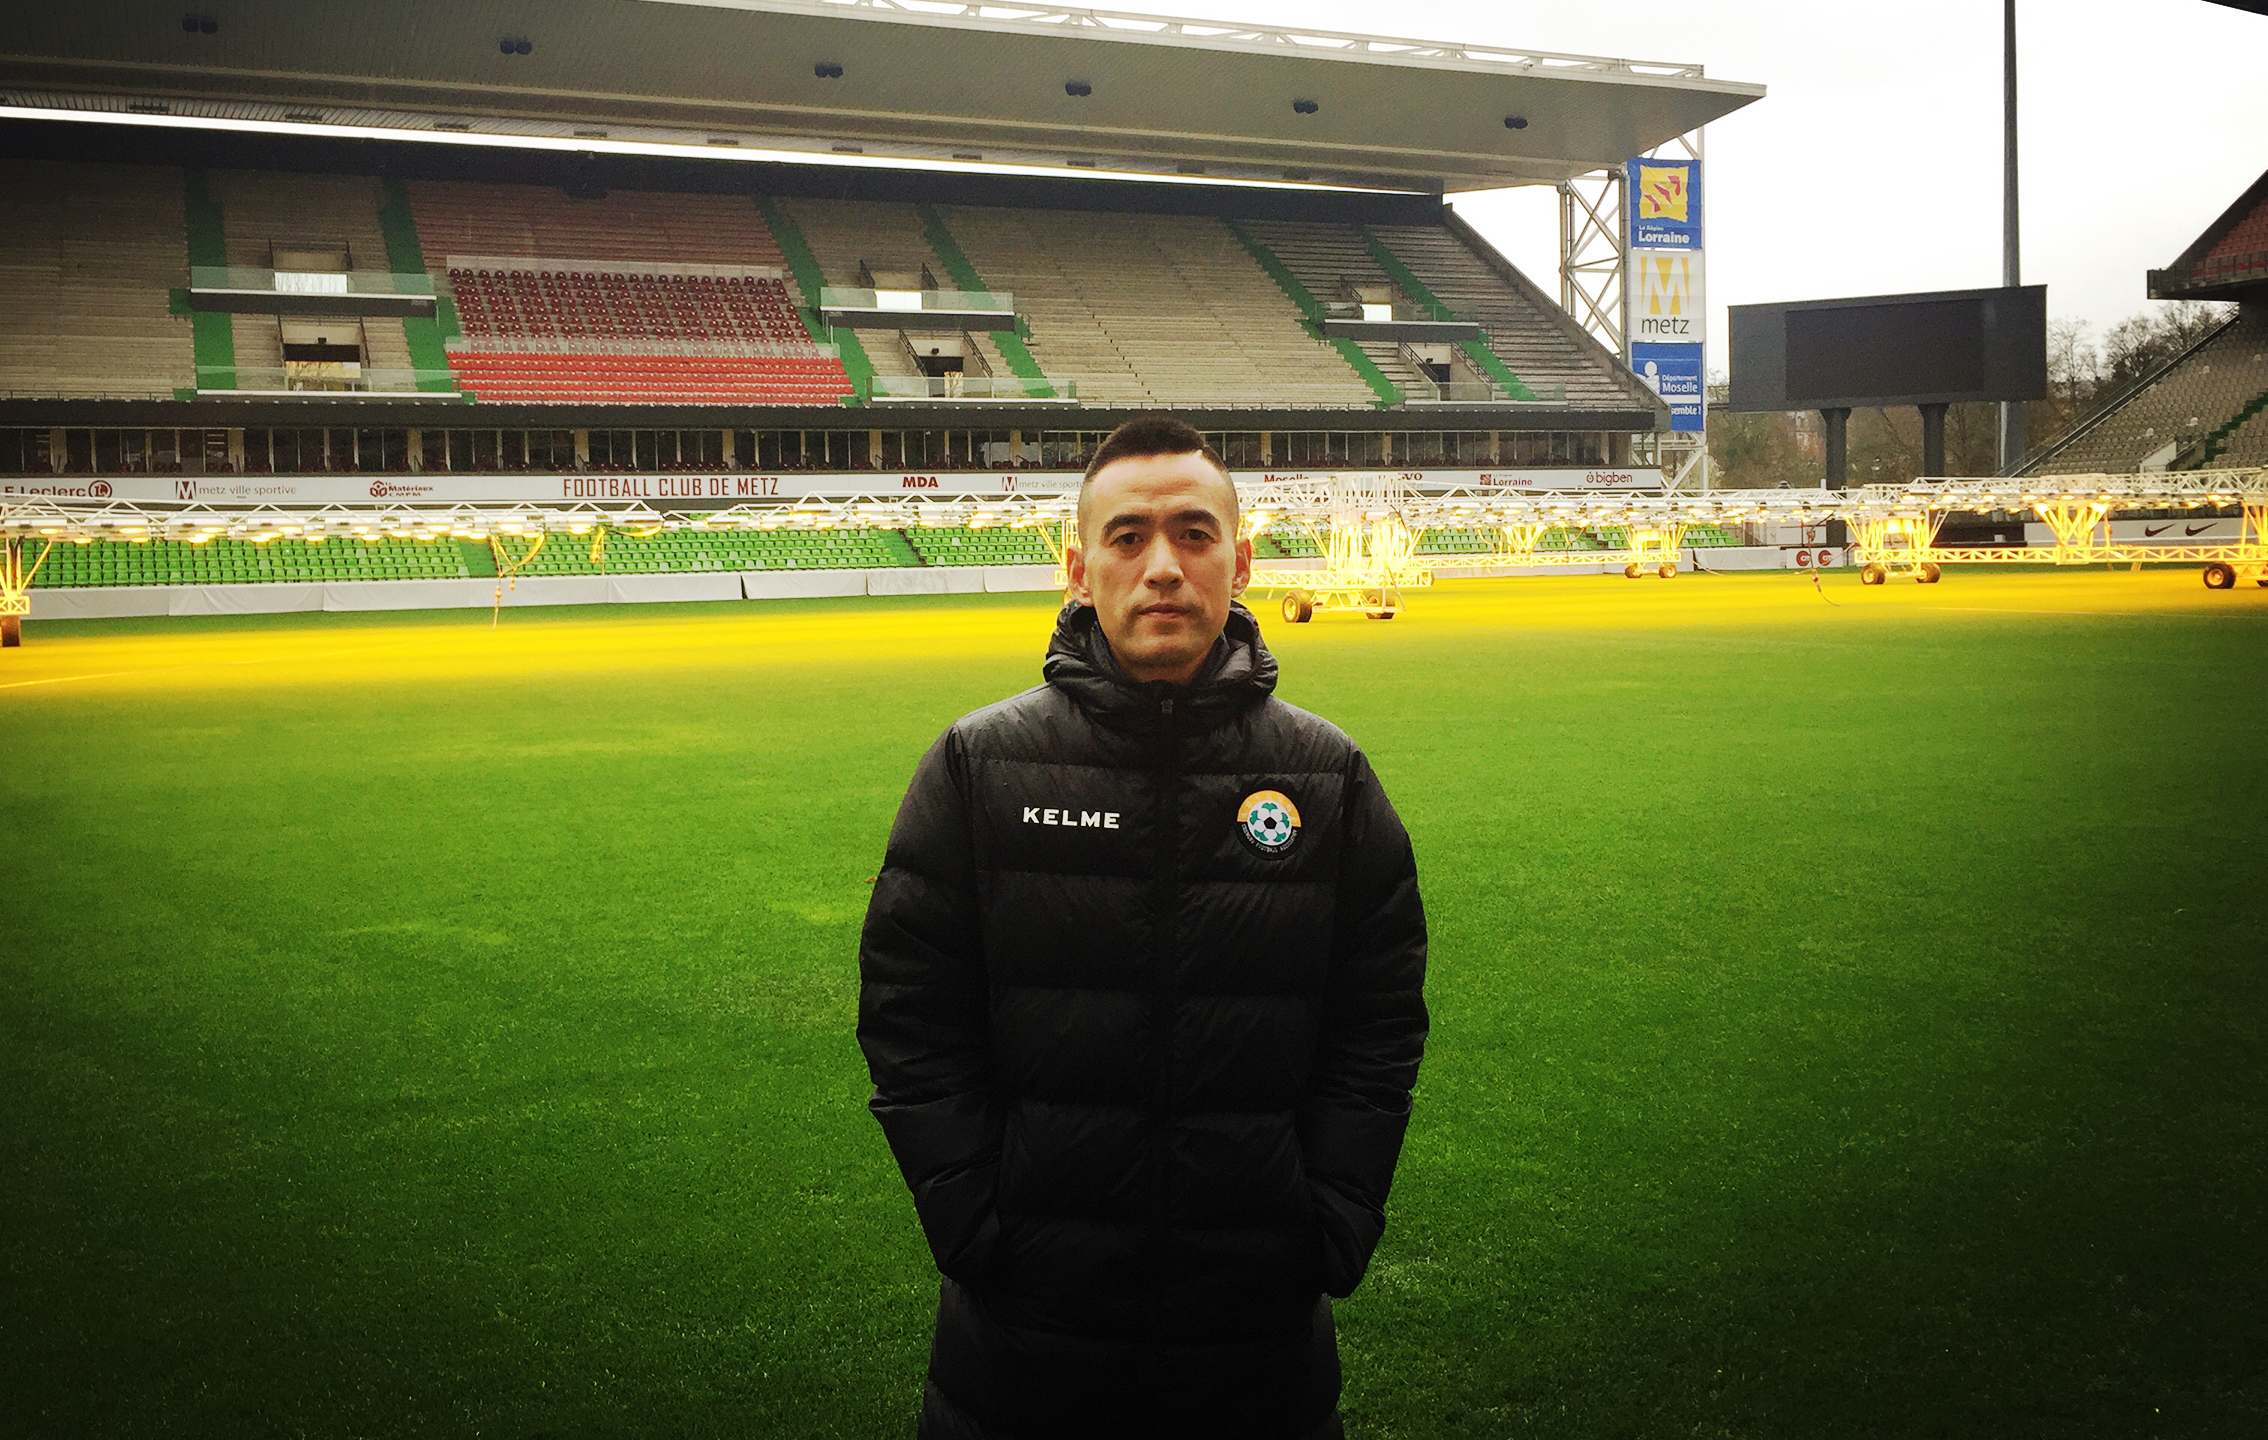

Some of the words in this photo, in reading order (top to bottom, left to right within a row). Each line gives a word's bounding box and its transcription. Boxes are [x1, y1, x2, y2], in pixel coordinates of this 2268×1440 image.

[1638, 231, 1690, 243] Lorraine
[1641, 317, 1690, 334] metz
[1662, 381, 1698, 392] Moselle
[902, 476, 939, 488] MDA
[1041, 480, 1057, 488] ville
[1493, 477, 1533, 486] Lorraine
[1595, 471, 1633, 486] bigben
[199, 486, 226, 494] metz
[229, 485, 251, 494] ville
[254, 485, 297, 496] sportive
[563, 478, 651, 497] FOOTBALL
[659, 478, 701, 496] CLUB
[710, 478, 730, 496] DE
[737, 477, 779, 496] METZ
[1022, 806, 1120, 829] KELME
